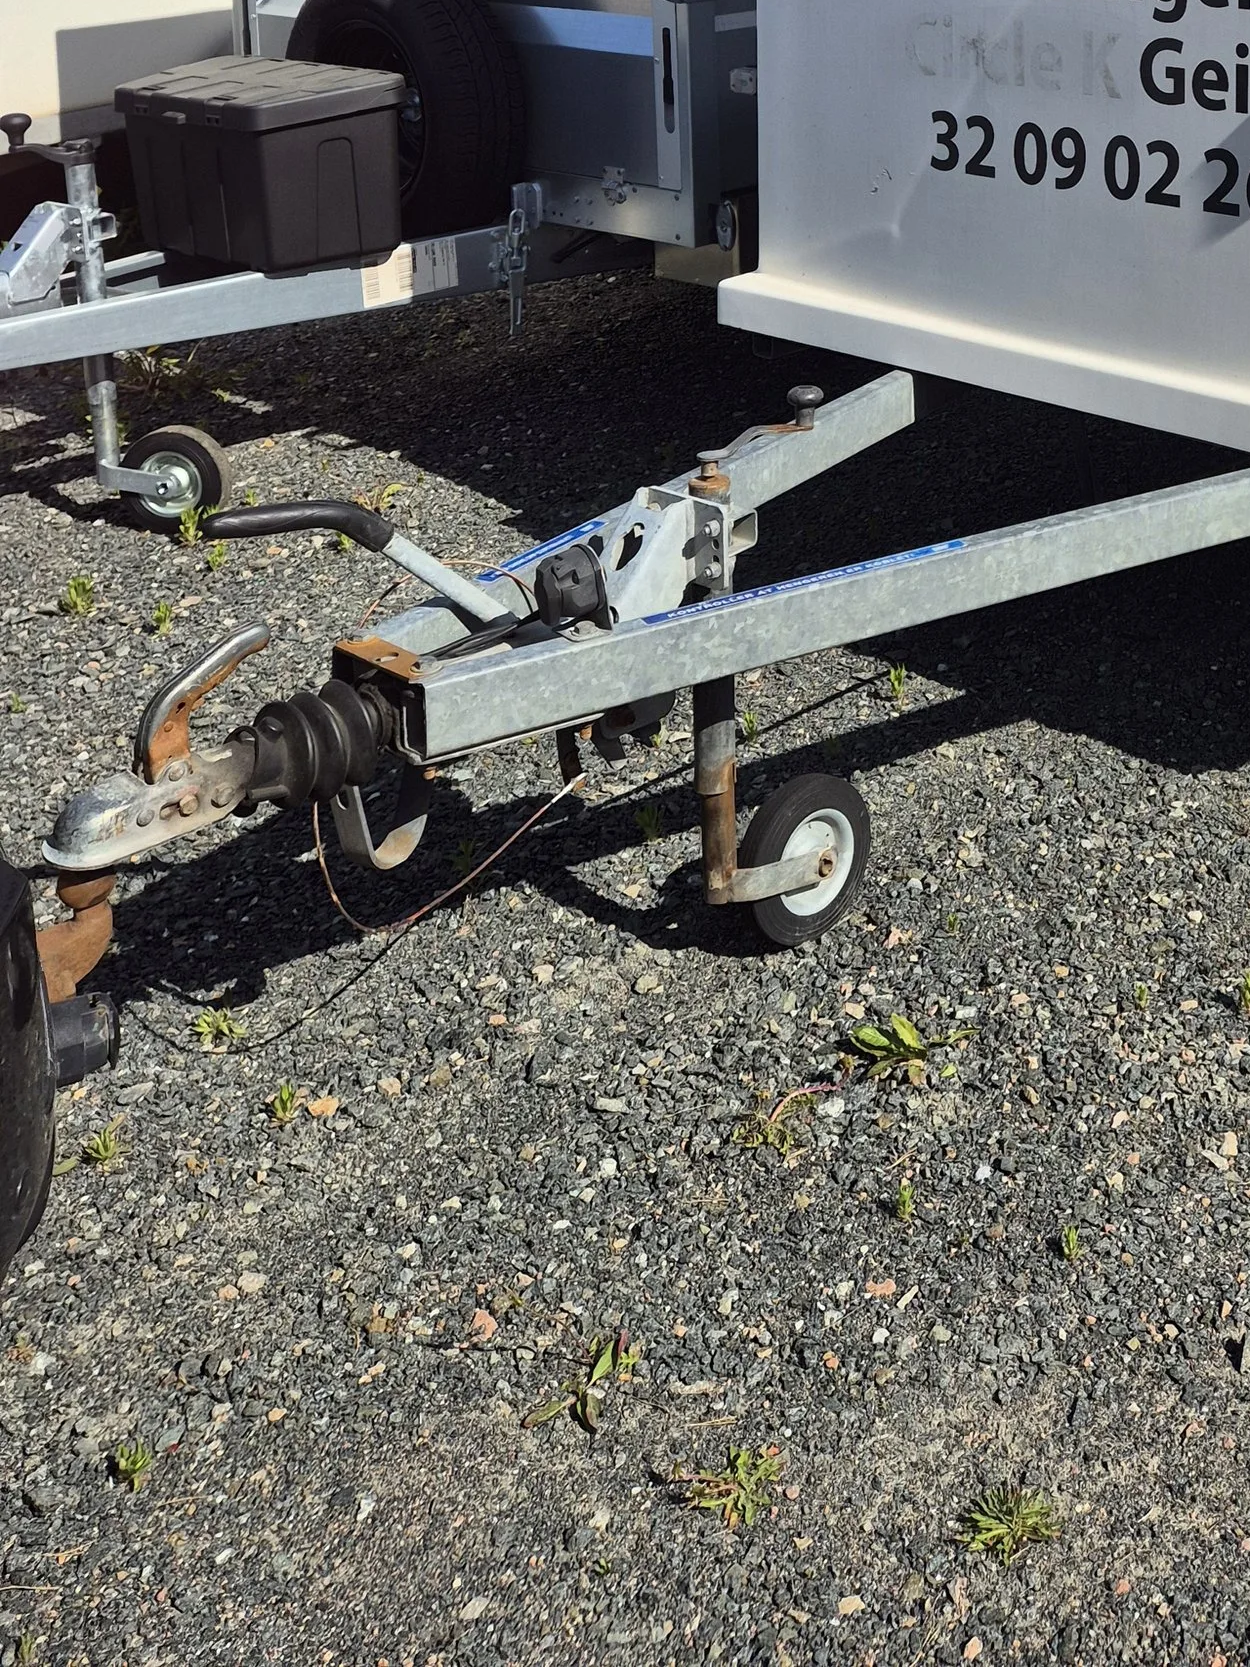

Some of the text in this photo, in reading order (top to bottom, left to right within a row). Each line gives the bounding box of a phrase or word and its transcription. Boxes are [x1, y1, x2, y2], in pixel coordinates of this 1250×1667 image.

[930, 110, 996, 179] 32
[1013, 121, 1087, 190] 09
[1103, 134, 1182, 208] 02
[667, 593, 754, 618] KONTROLLER
[757, 586, 774, 597] AT
